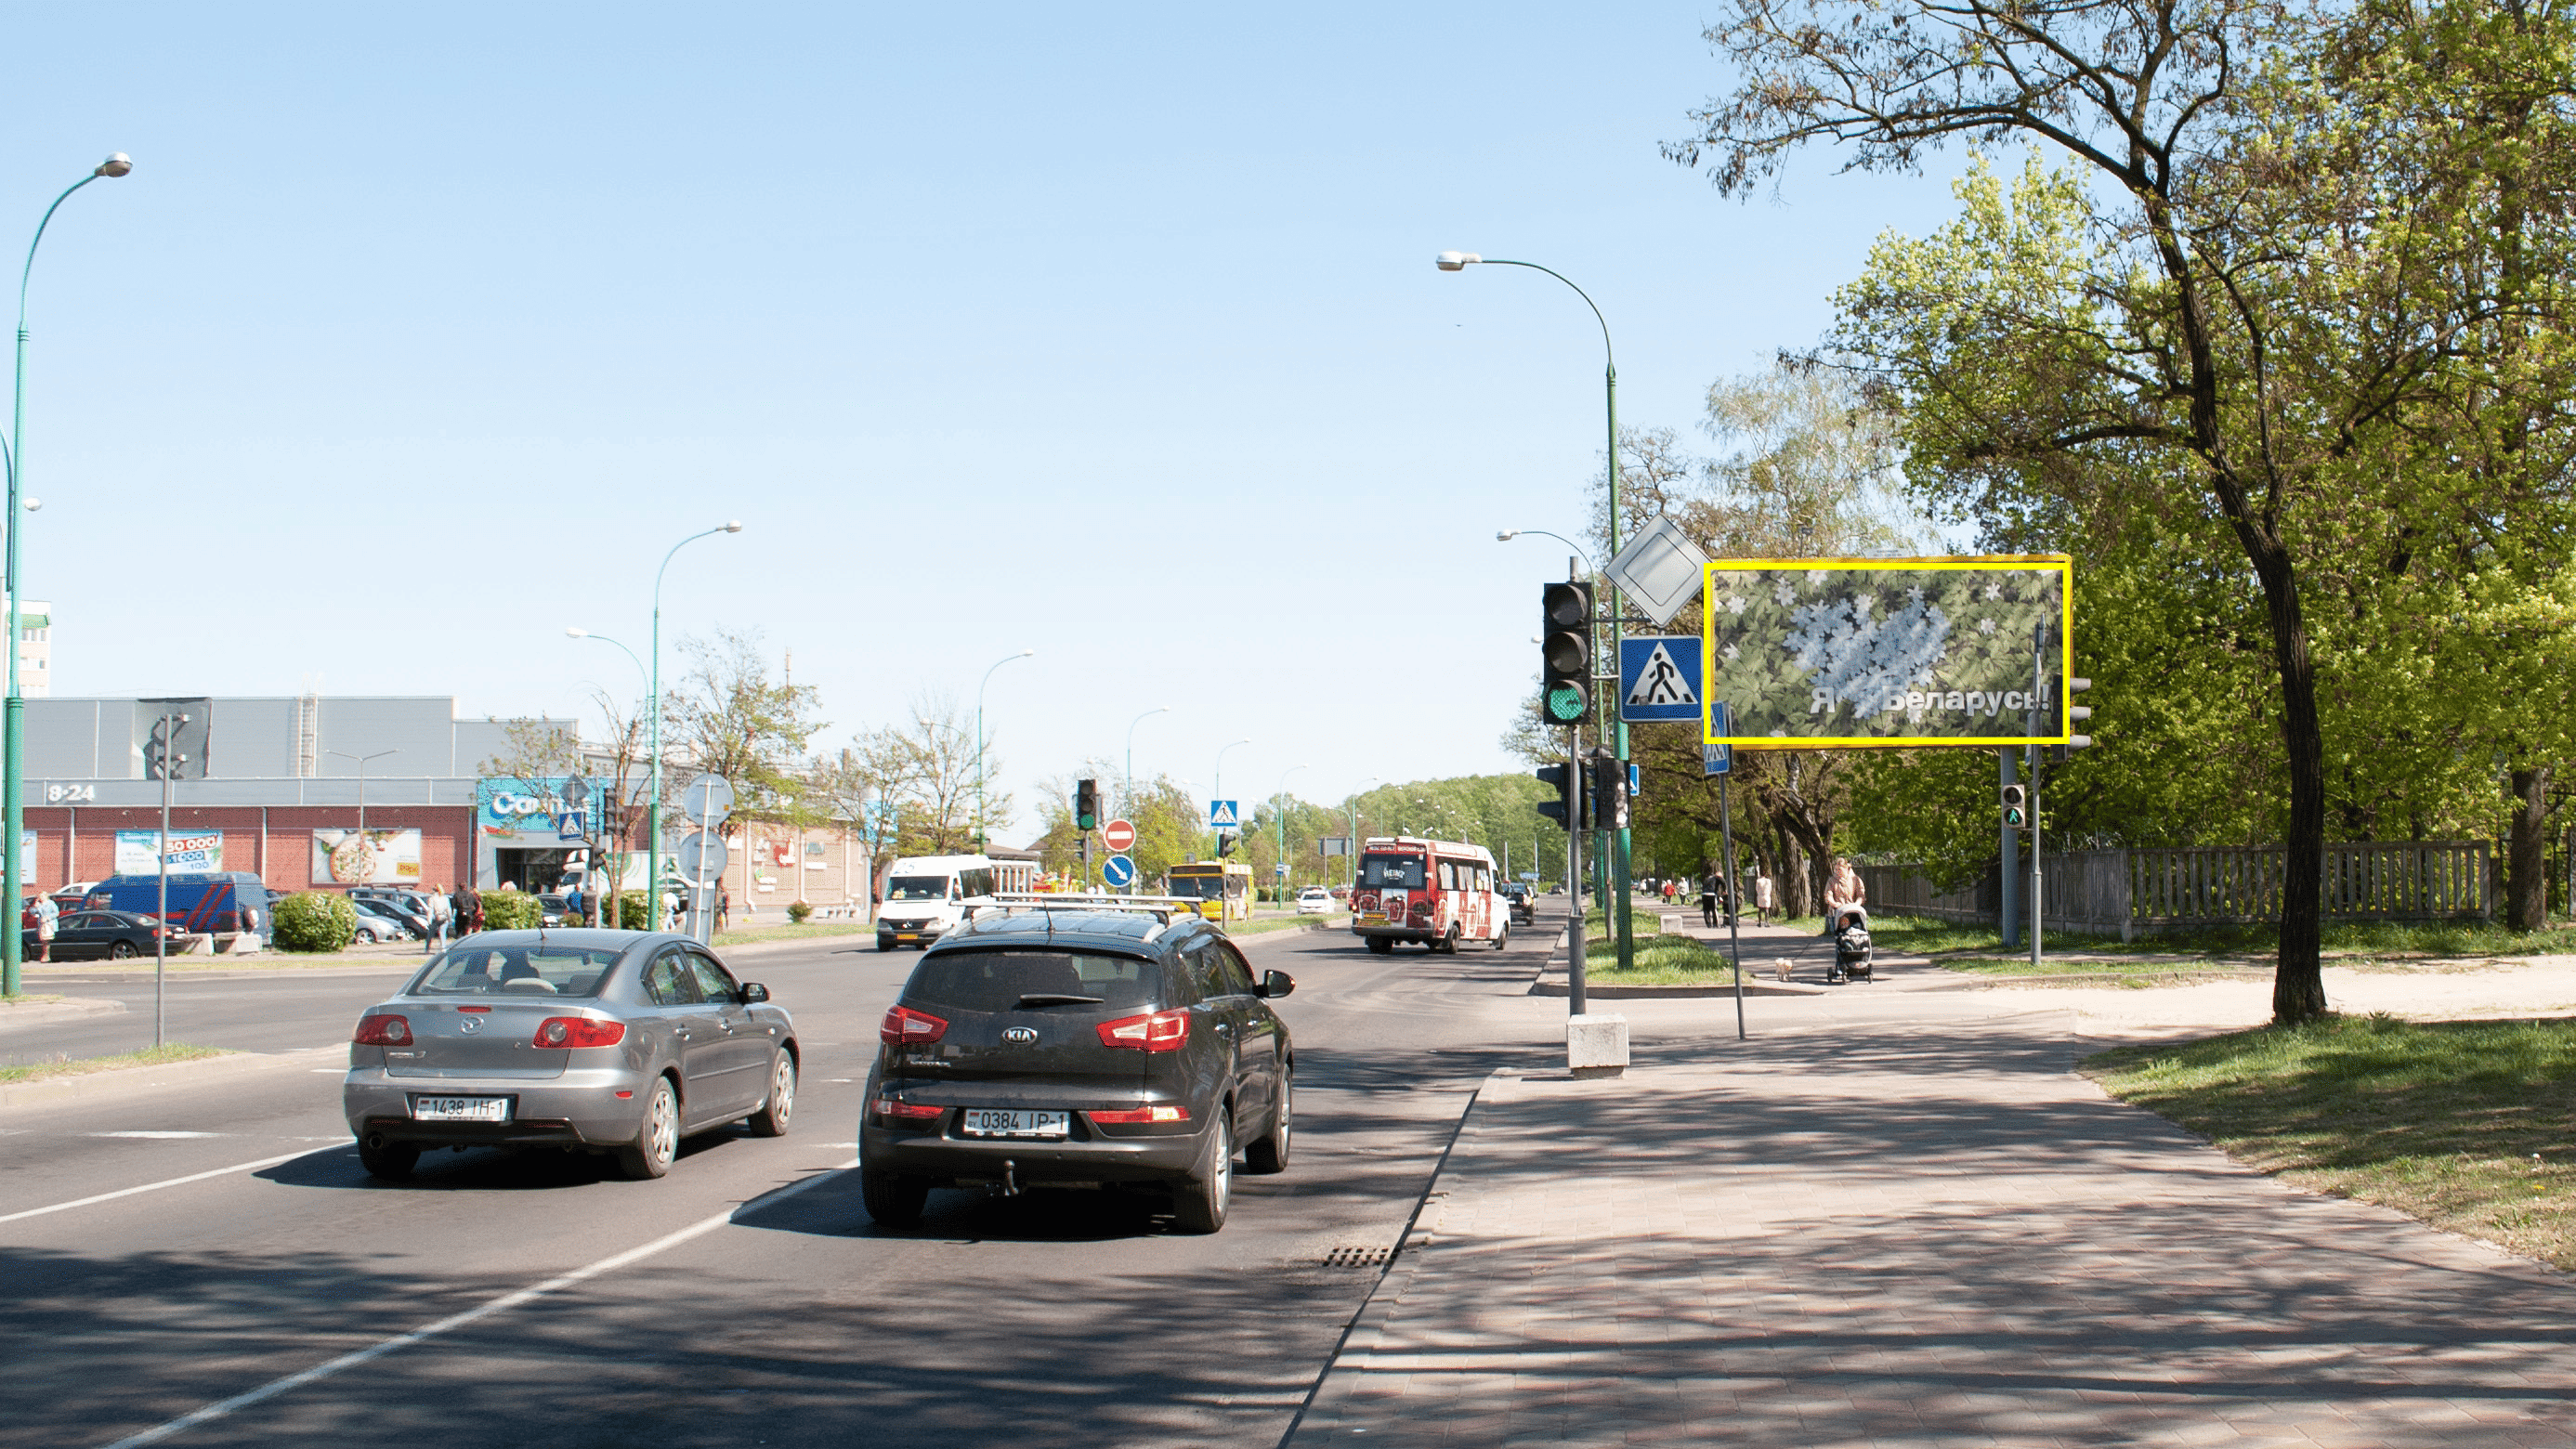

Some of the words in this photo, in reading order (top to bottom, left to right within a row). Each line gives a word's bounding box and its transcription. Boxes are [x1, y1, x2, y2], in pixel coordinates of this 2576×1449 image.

[1810, 686, 1836, 714] Я
[1007, 1029, 1032, 1041] KIA
[432, 1099, 465, 1116] 1438
[981, 1112, 1020, 1129] 0384
[1029, 1113, 1066, 1131] IP-1
